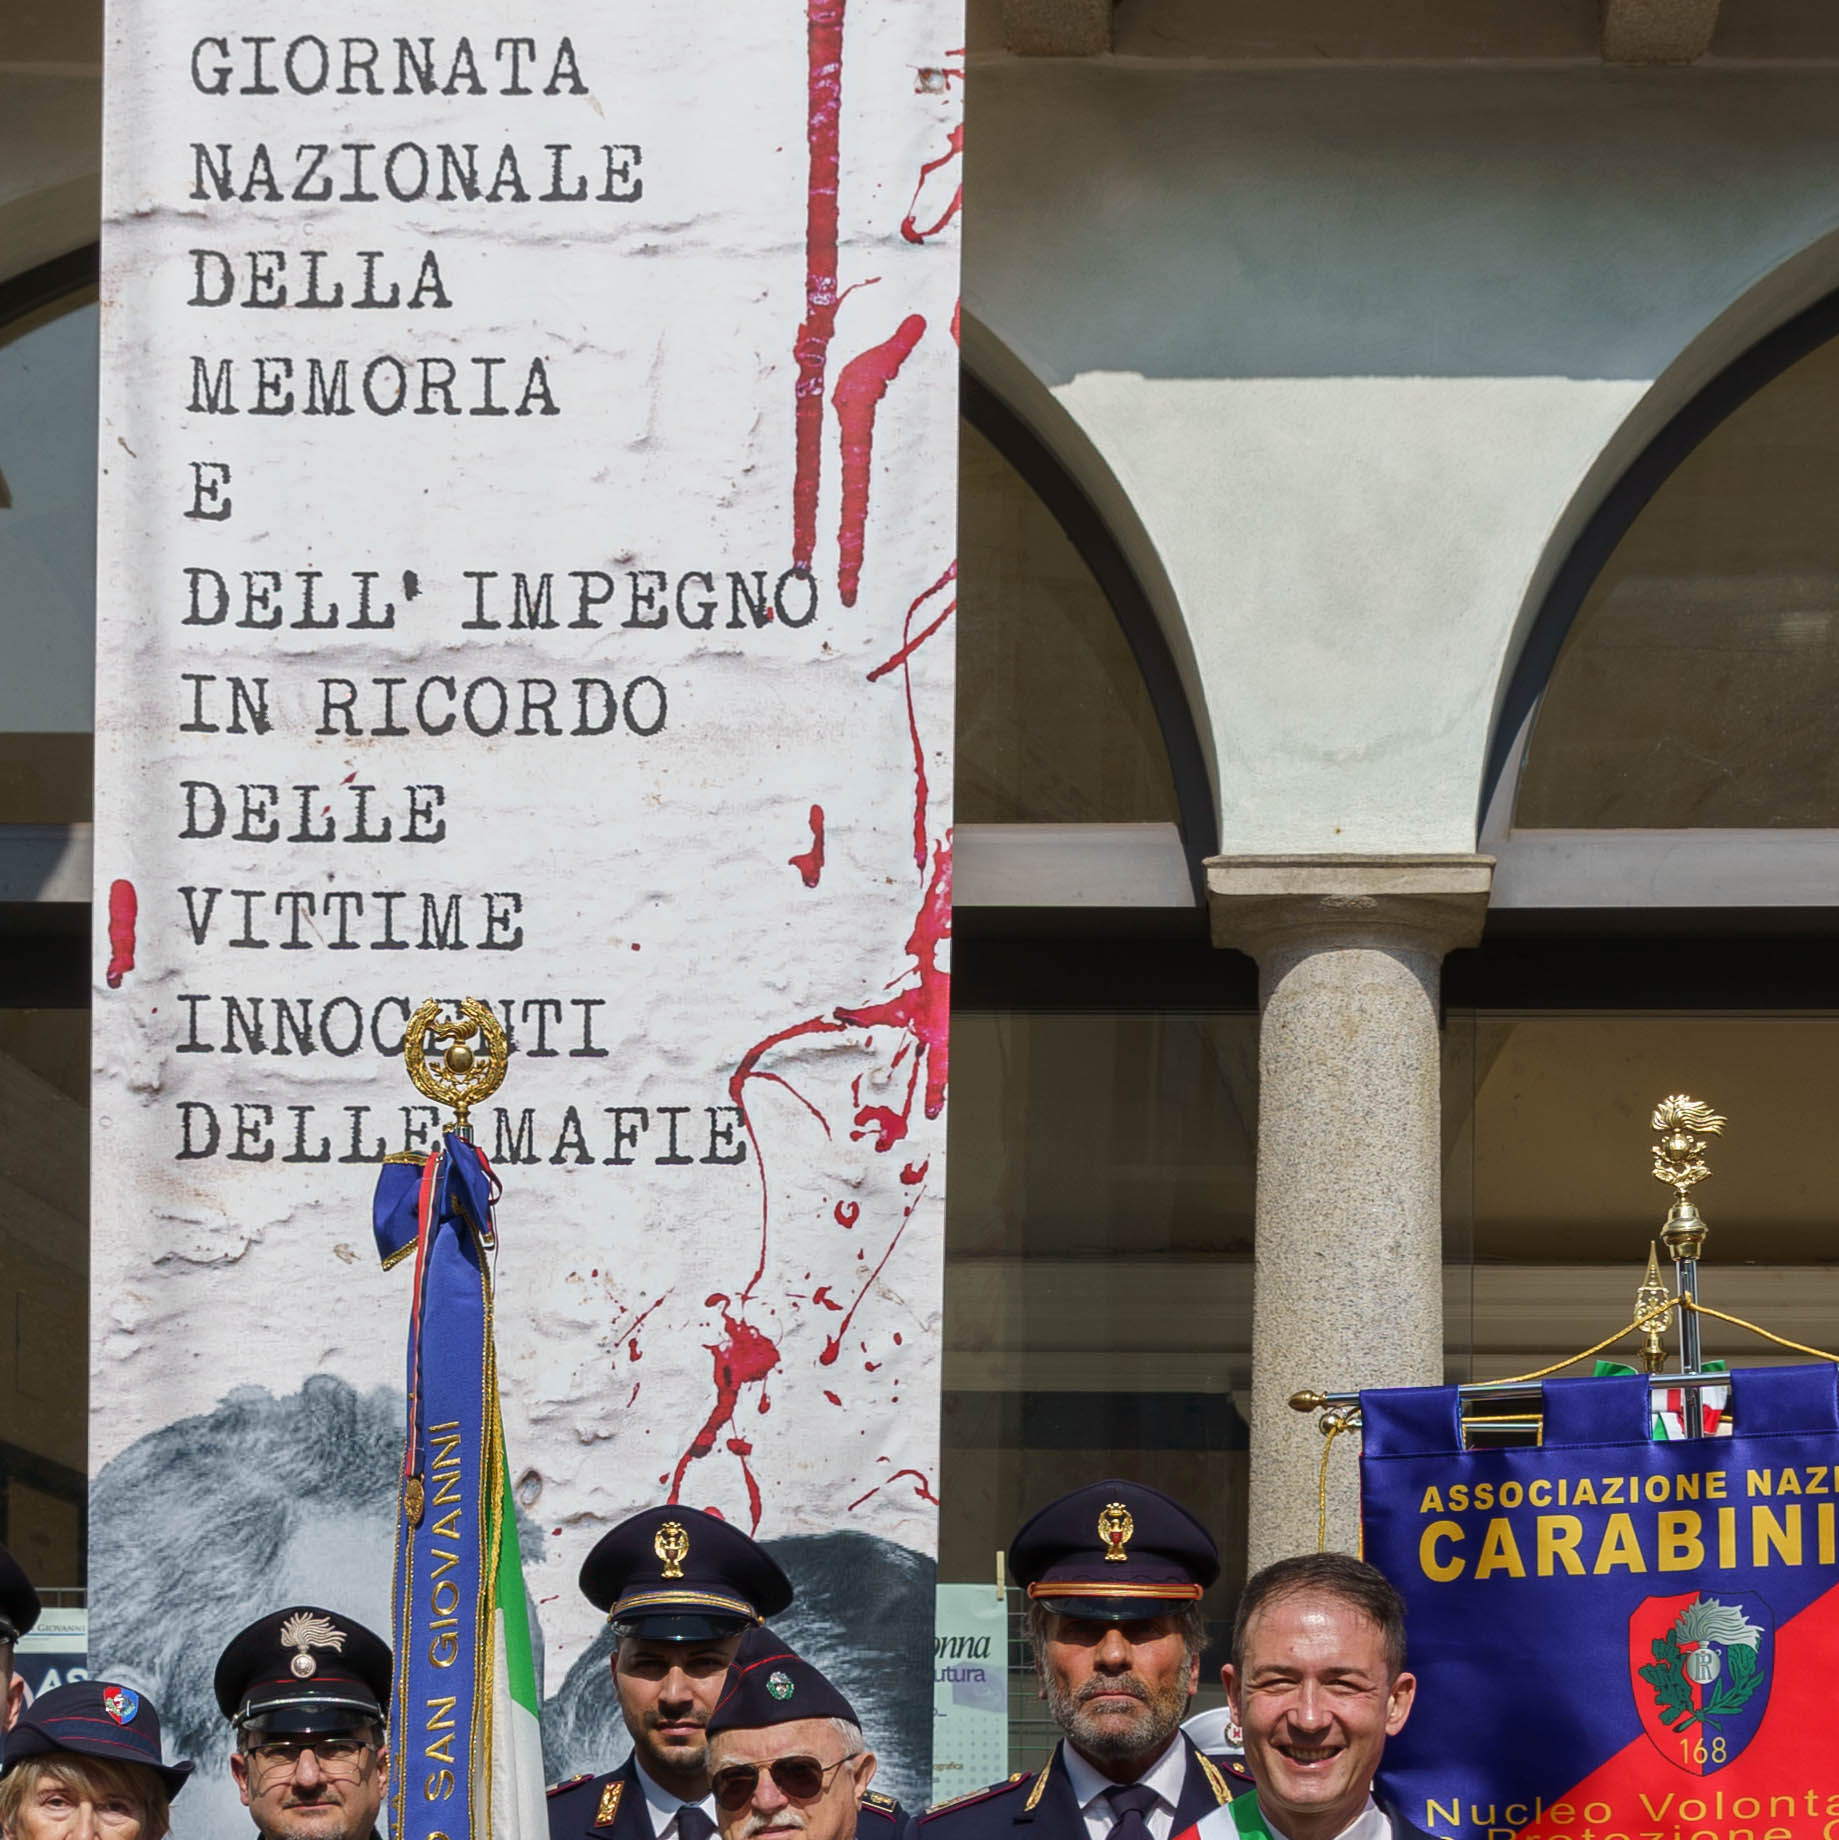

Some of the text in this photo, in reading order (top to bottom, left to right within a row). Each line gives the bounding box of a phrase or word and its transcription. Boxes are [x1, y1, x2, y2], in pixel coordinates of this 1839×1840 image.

[191, 35, 589, 95] GIORNATA
[190, 142, 644, 203] NAZIONALE
[187, 249, 453, 309] DELLA
[186, 355, 561, 417] MEMORIA
[183, 461, 233, 521] E
[182, 566, 819, 630] DELL' IMPEGNO
[179, 673, 669, 738] IN RICORDO
[178, 780, 447, 844] DELLE
[178, 886, 524, 951] VITTIME
[490, 1104, 748, 1166] MAFIE
[1419, 1471, 1727, 1514] ASSOCIAZIONE
[428, 1420, 461, 1669] GIOVANNI
[424, 1695, 456, 1801] SAN
[1679, 1736, 1728, 1764] 168
[1425, 1796, 1612, 1828] Nucleo
